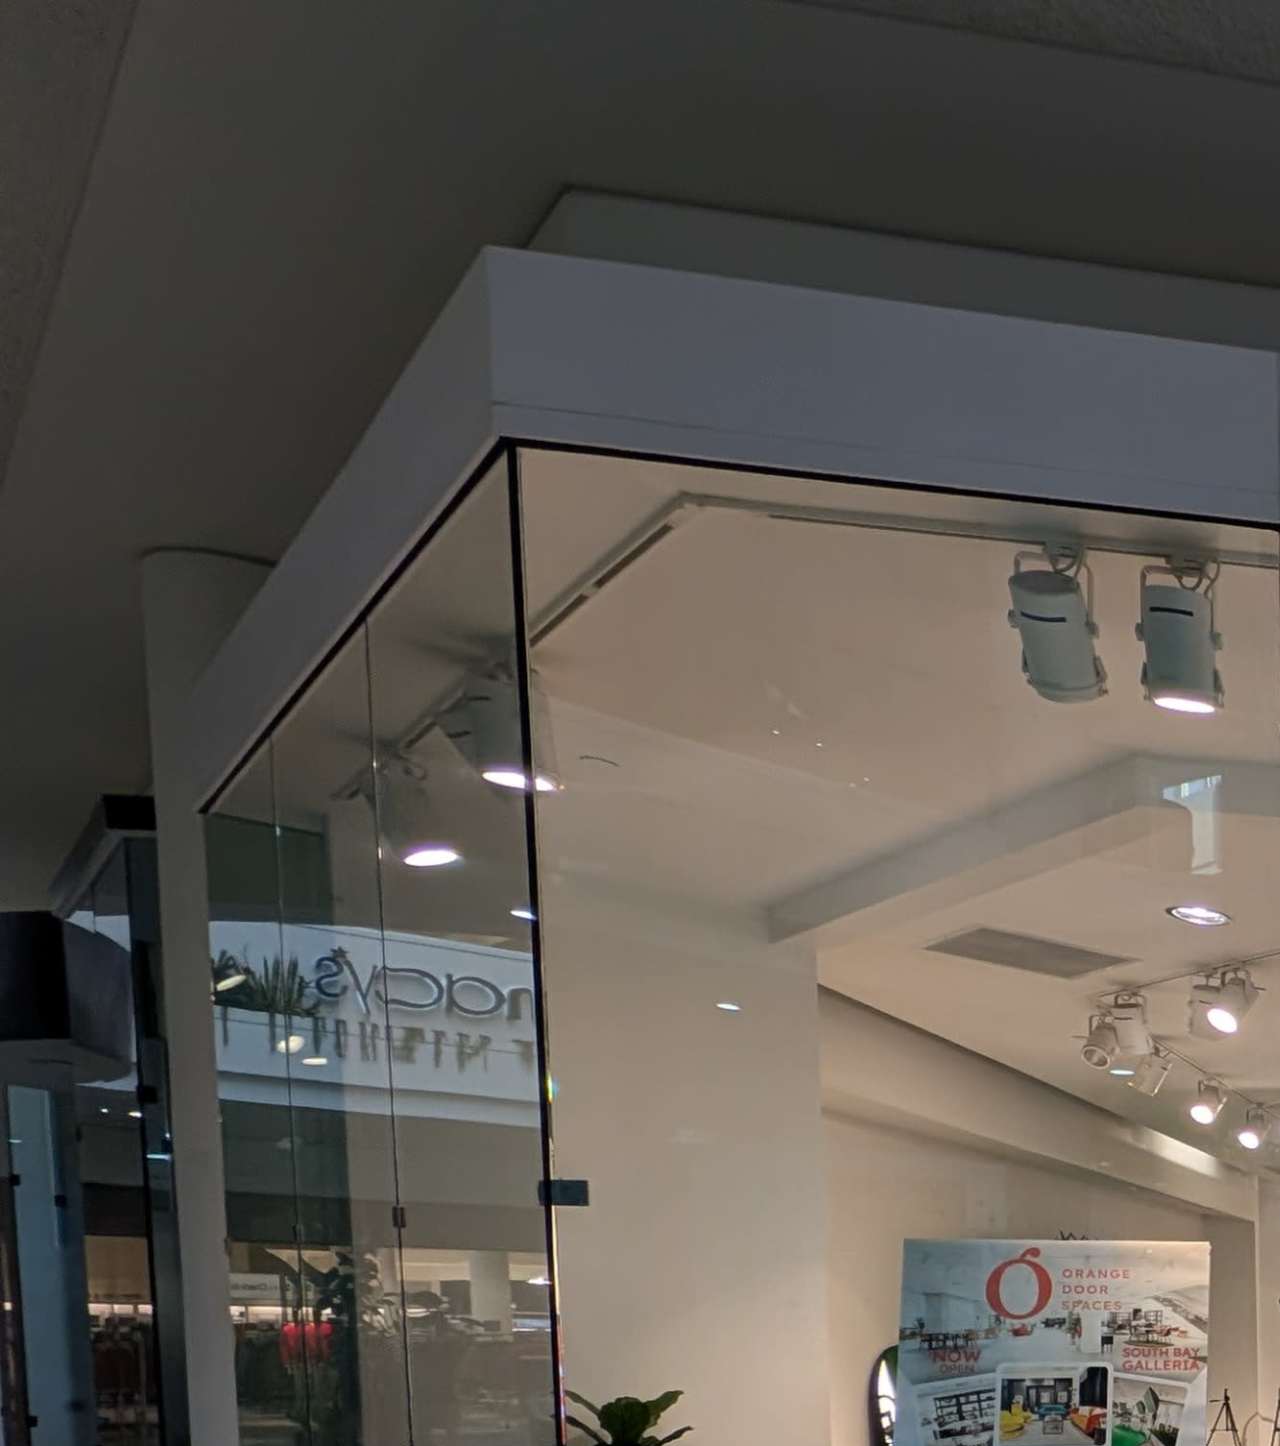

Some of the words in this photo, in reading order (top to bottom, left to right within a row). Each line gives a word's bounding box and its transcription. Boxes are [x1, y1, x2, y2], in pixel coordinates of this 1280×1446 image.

[1062, 1268, 1131, 1280] ORANGE
[1062, 1284, 1109, 1295] DOOR
[1062, 1300, 1122, 1311] SPACES
[930, 1349, 982, 1363] NOW
[1122, 1347, 1169, 1358] SOUTH
[1173, 1347, 1201, 1358] BAY
[1122, 1359, 1200, 1371] GALLERIA
